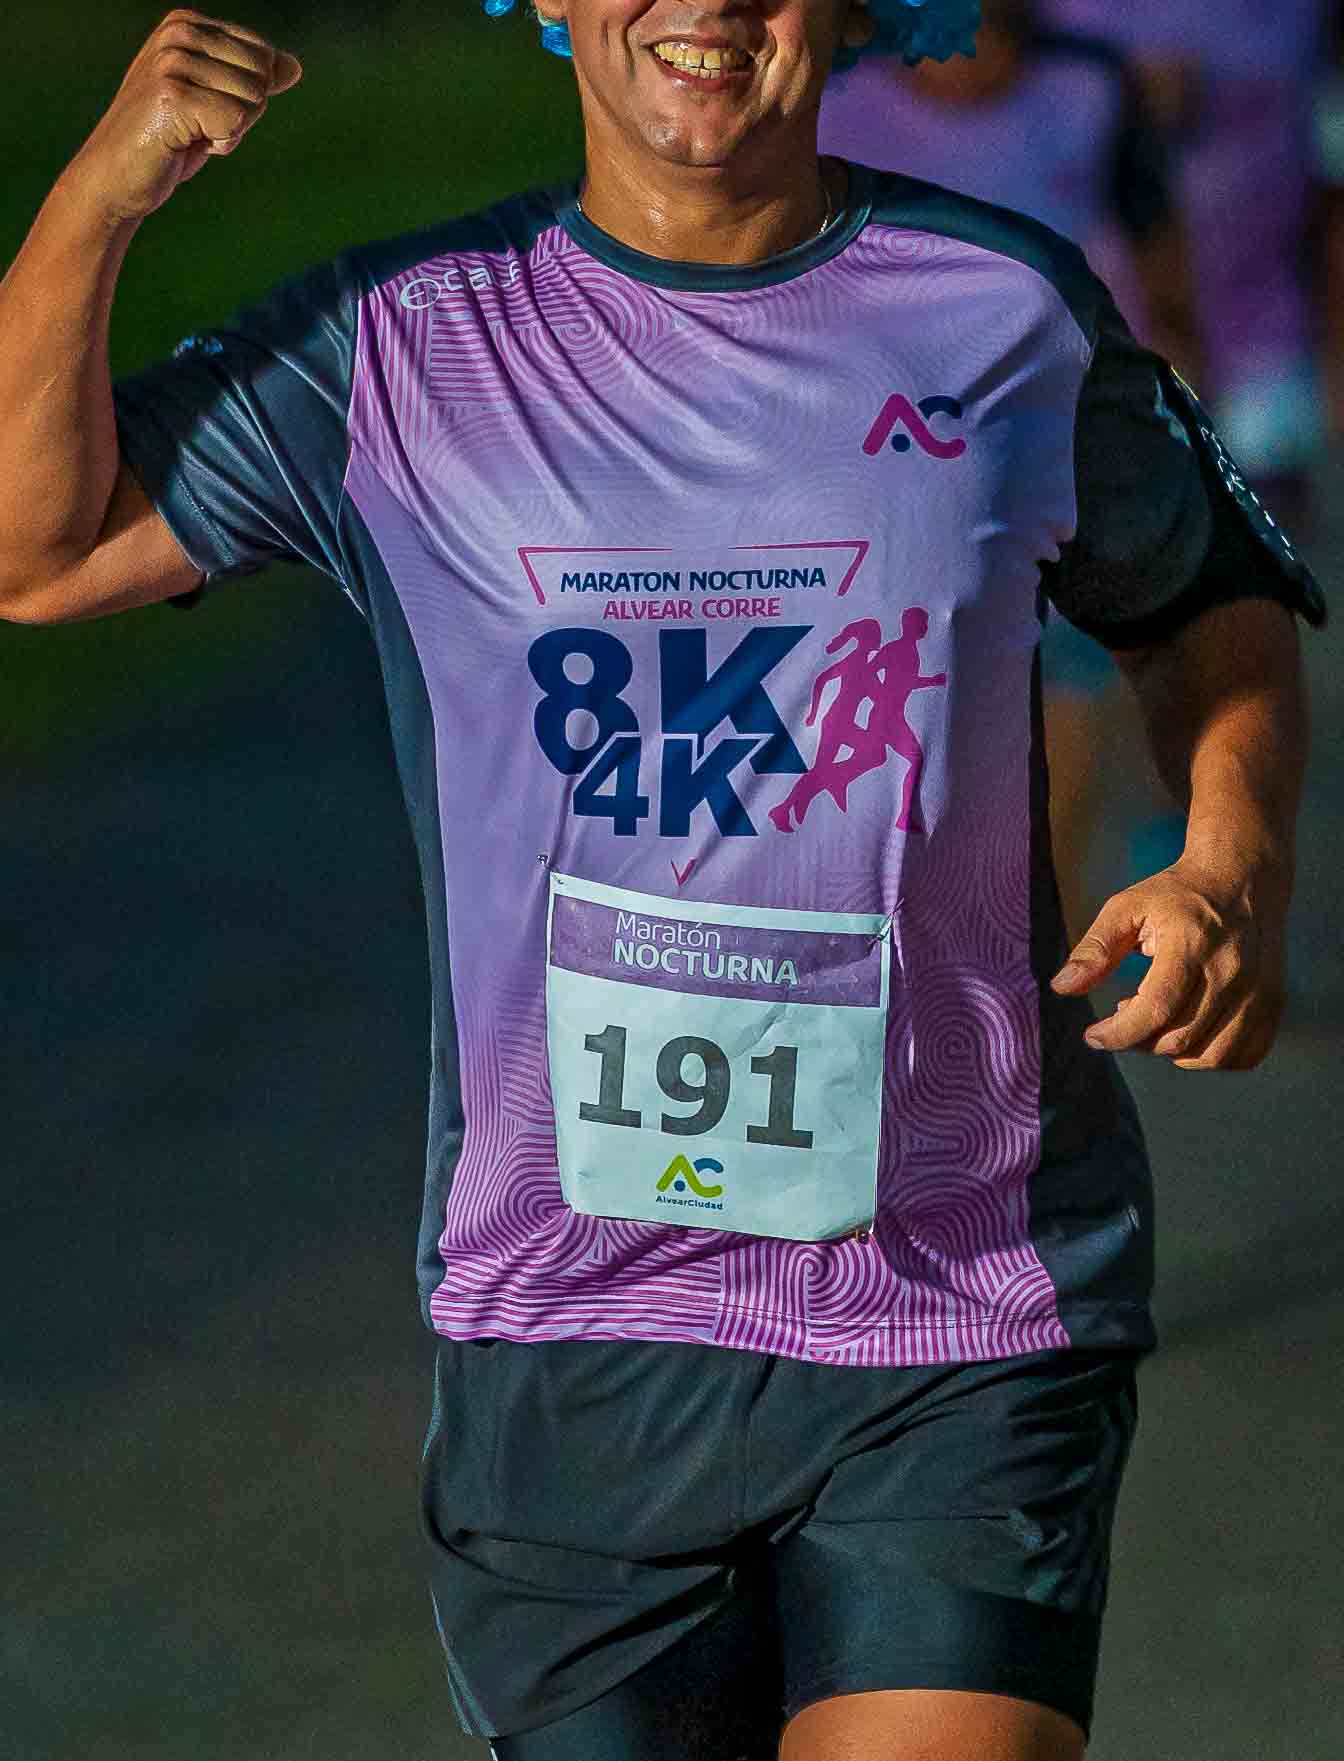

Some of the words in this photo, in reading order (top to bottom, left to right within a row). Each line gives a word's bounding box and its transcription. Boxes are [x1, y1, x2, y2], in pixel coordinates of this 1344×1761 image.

[560, 571, 681, 593] MARATON
[689, 567, 827, 590] NOCTURNA
[603, 599, 694, 620] ALVEAR
[701, 597, 782, 618] CORRE
[527, 624, 815, 776] 8K
[573, 735, 759, 837] 4K
[615, 911, 721, 950] Maratón
[614, 938, 799, 986] NOCTURNA
[578, 1024, 814, 1150] 191
